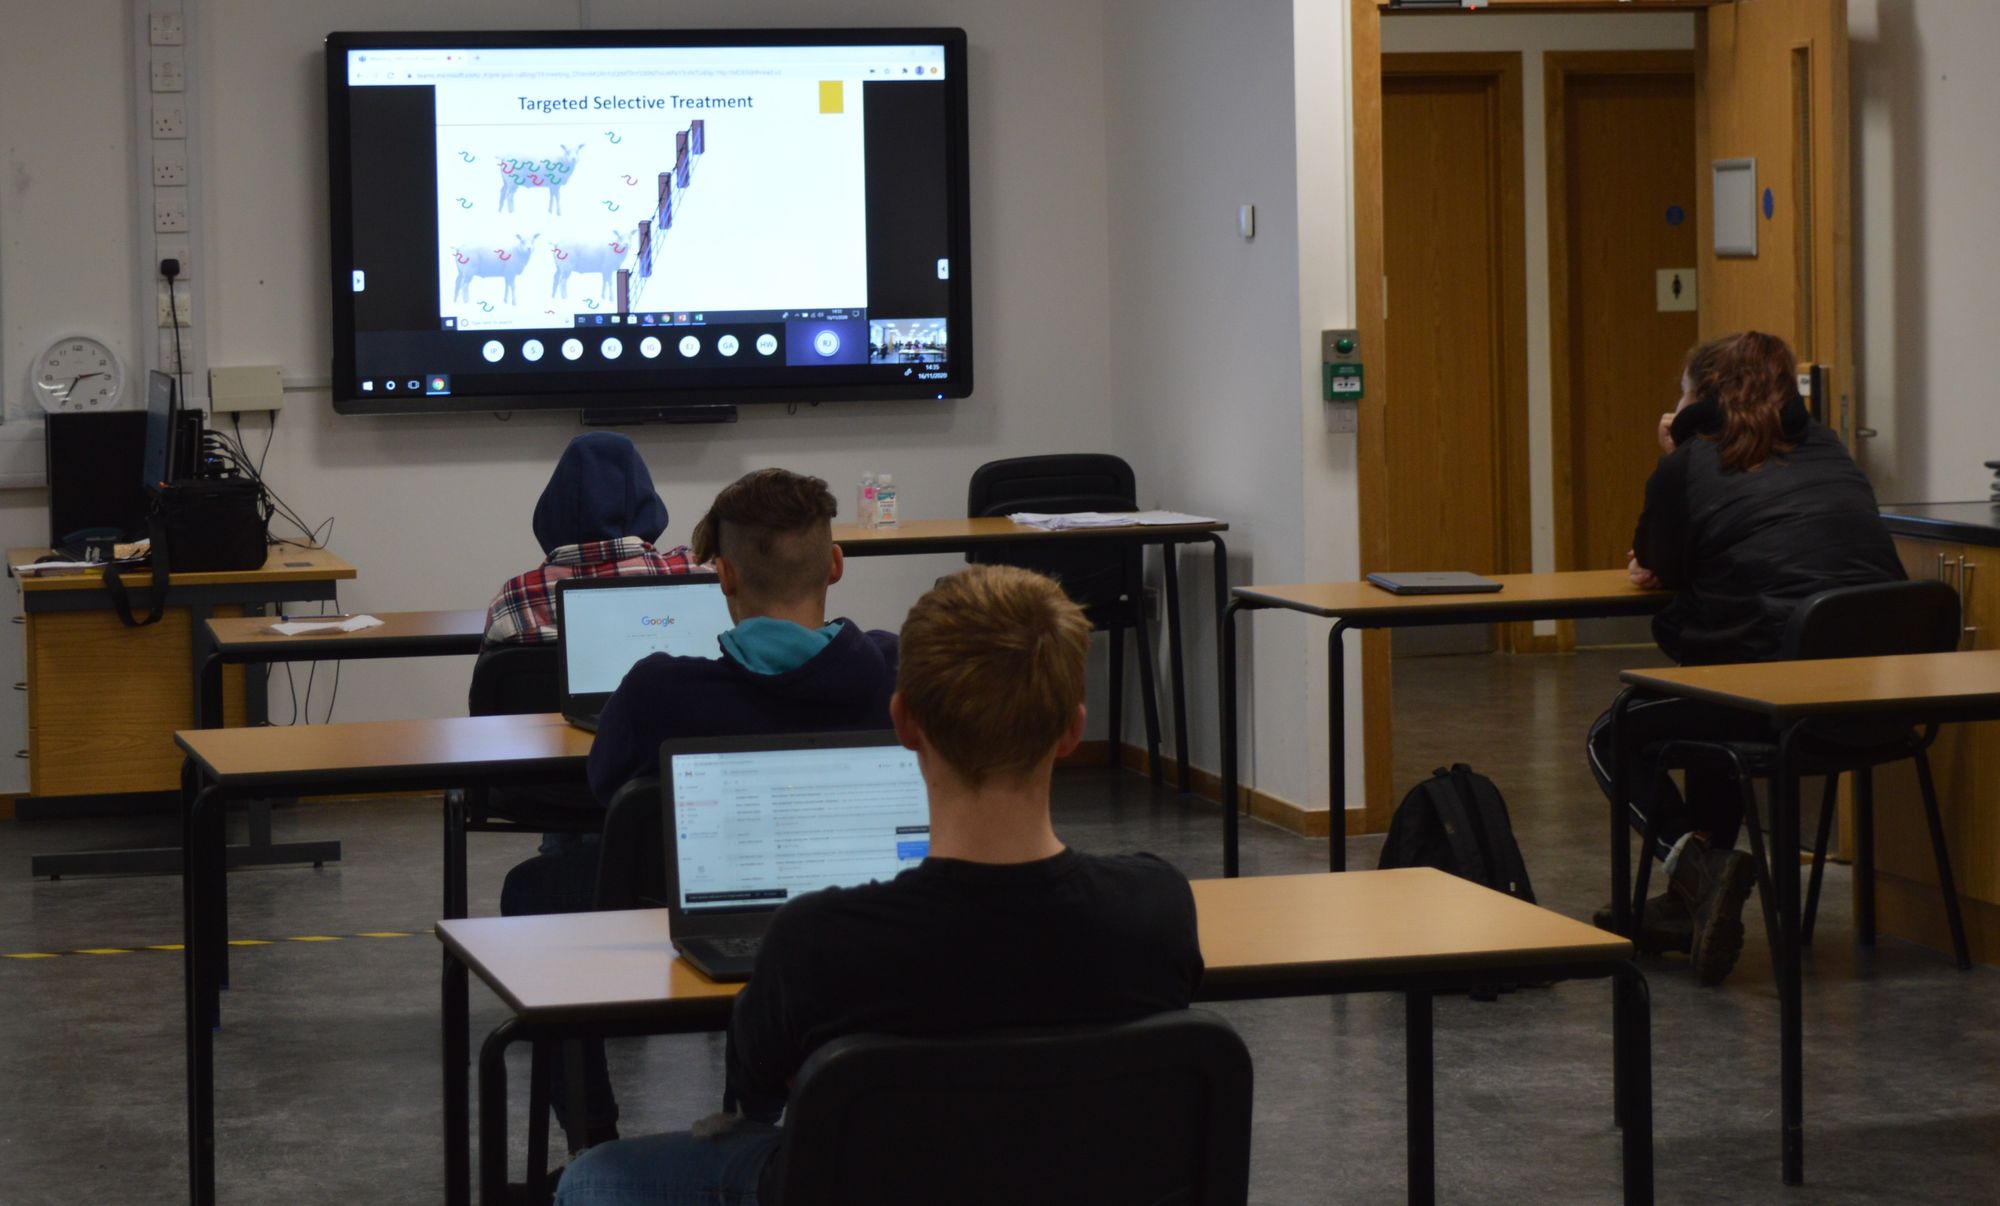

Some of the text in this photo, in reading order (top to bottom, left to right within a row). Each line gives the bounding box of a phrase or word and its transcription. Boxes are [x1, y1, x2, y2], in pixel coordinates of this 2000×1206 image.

[518, 94, 754, 114] Targeted Selective Treatment
[99, 388, 107, 396] 4
[90, 398, 98, 406] 5
[641, 615, 675, 627] Google
